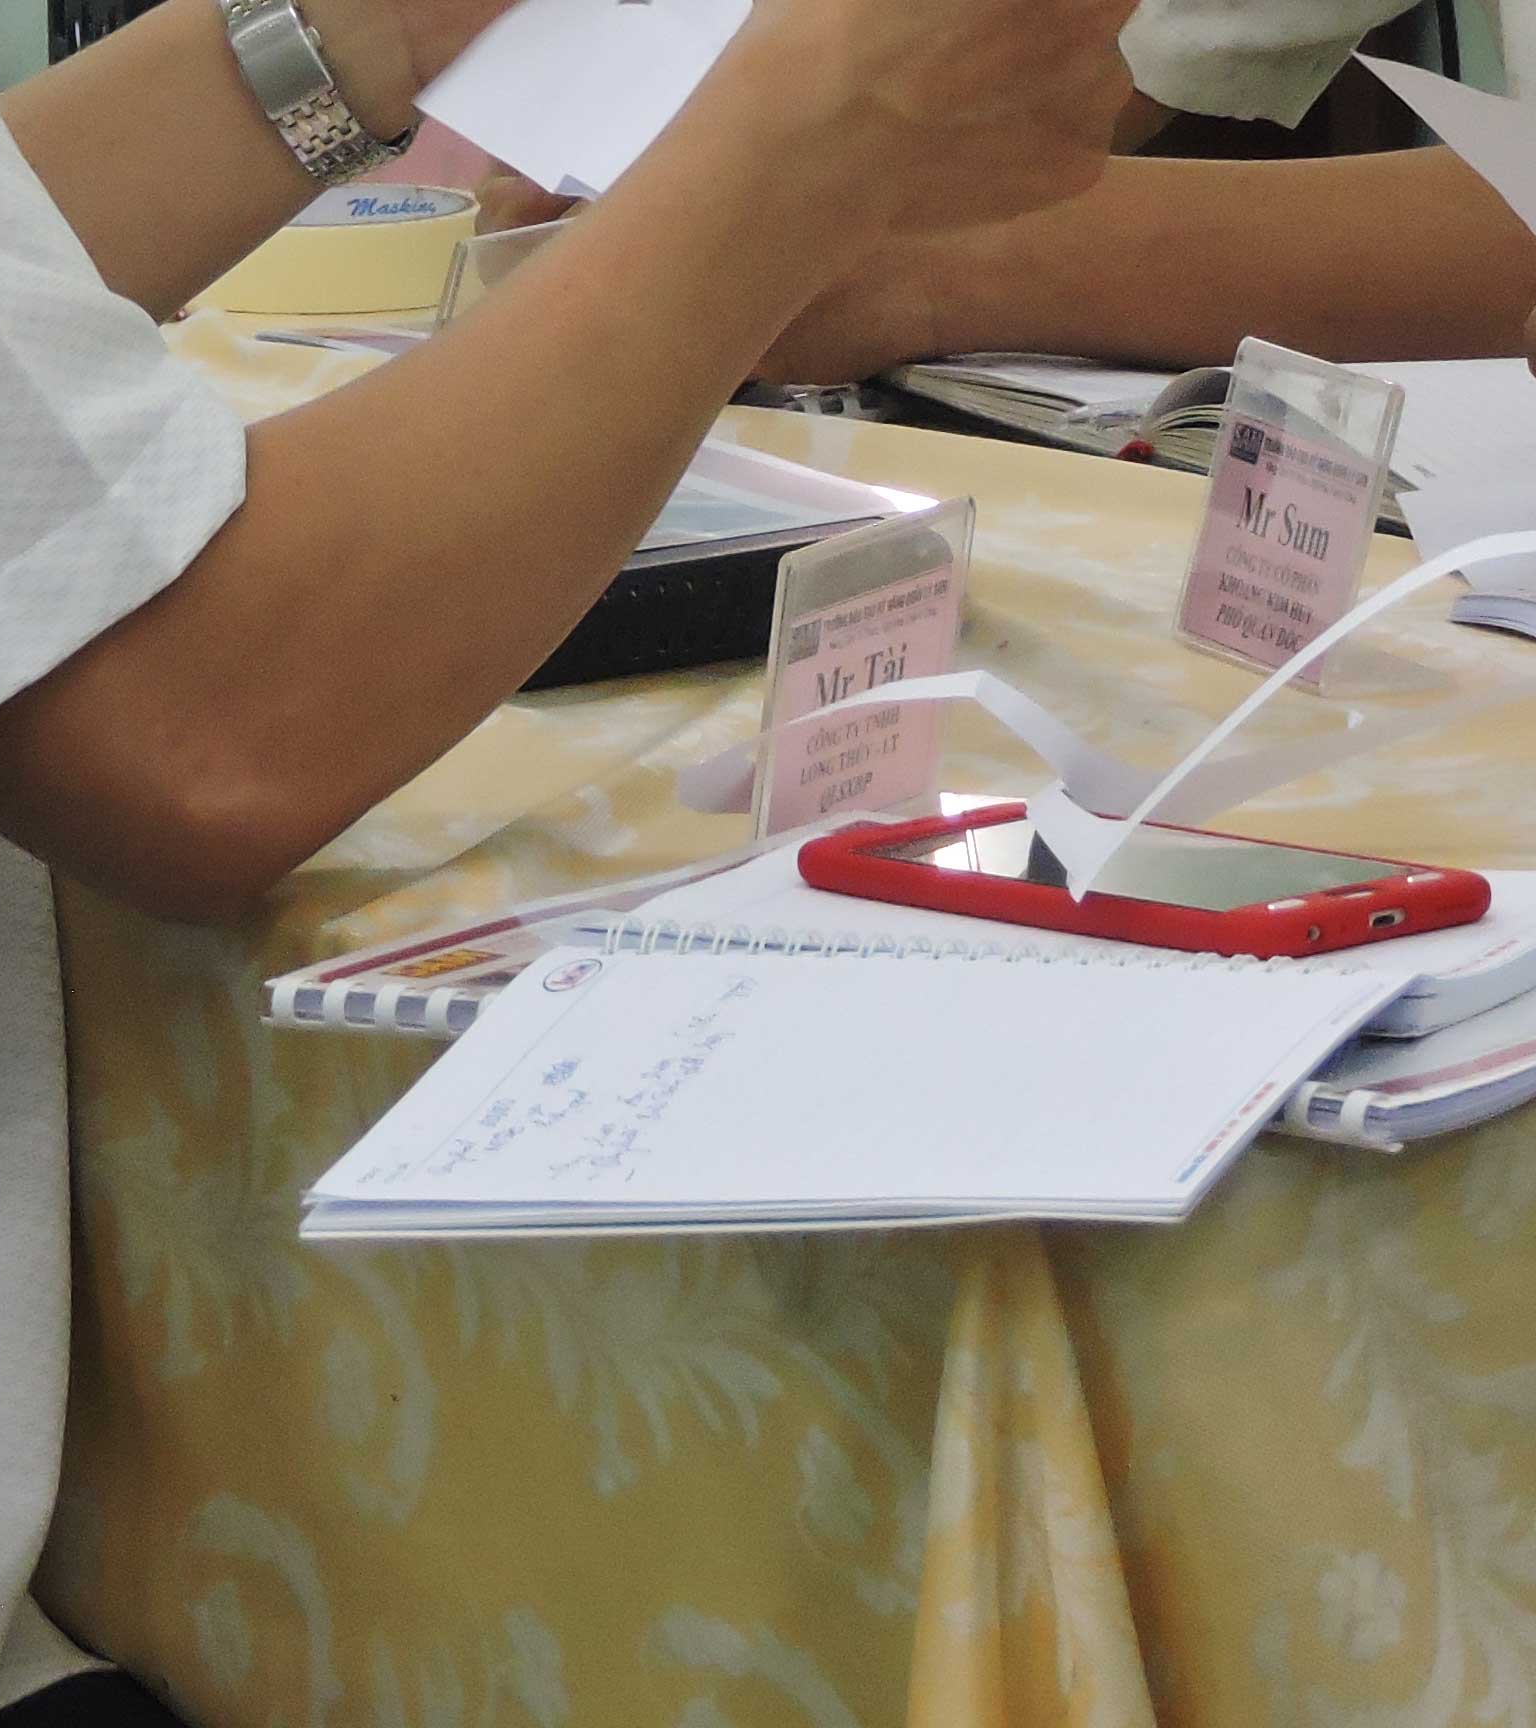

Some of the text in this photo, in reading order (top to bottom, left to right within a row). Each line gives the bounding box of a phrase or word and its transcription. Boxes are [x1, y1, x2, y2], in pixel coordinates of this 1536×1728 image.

[1236, 487, 1330, 561] Mr Sum
[817, 641, 908, 707] Mr Tài
